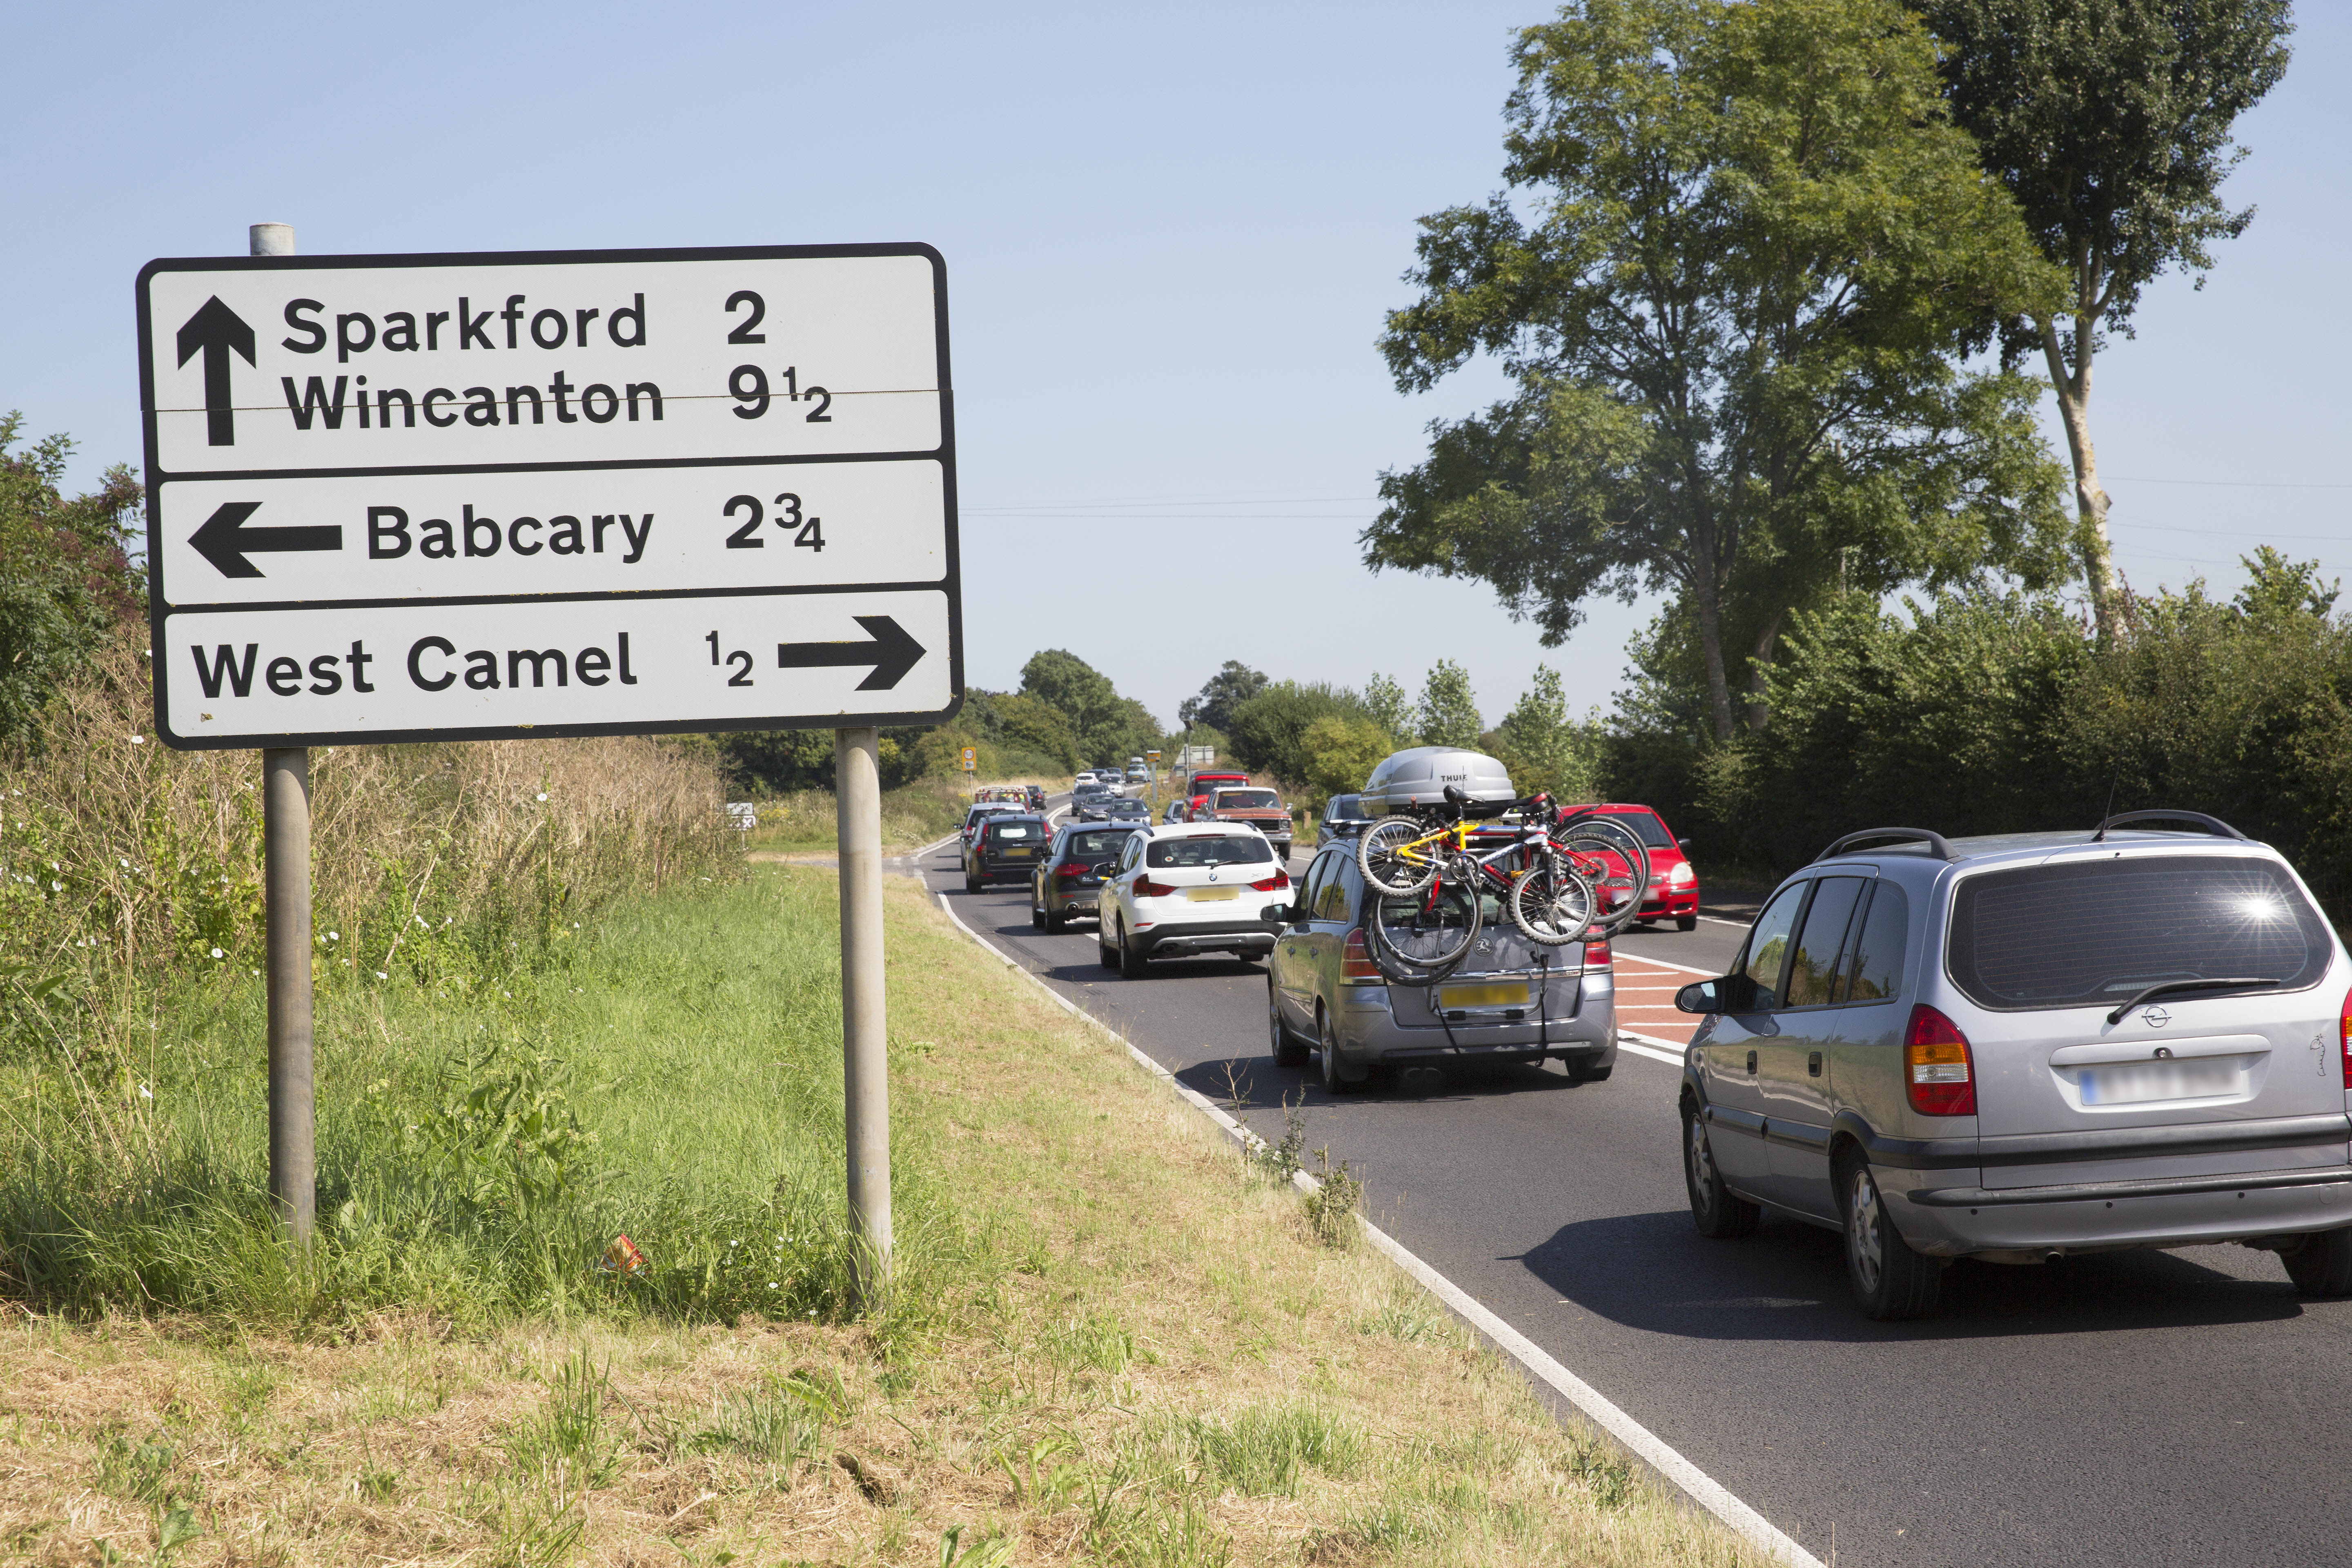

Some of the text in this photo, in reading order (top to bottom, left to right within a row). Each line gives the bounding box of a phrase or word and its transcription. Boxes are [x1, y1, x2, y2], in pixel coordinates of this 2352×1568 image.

[281, 290, 766, 363] Sparkford 2
[281, 370, 664, 430] Wincanton
[368, 504, 654, 564] Babcary
[191, 639, 375, 698] West
[407, 631, 638, 692] Camel
